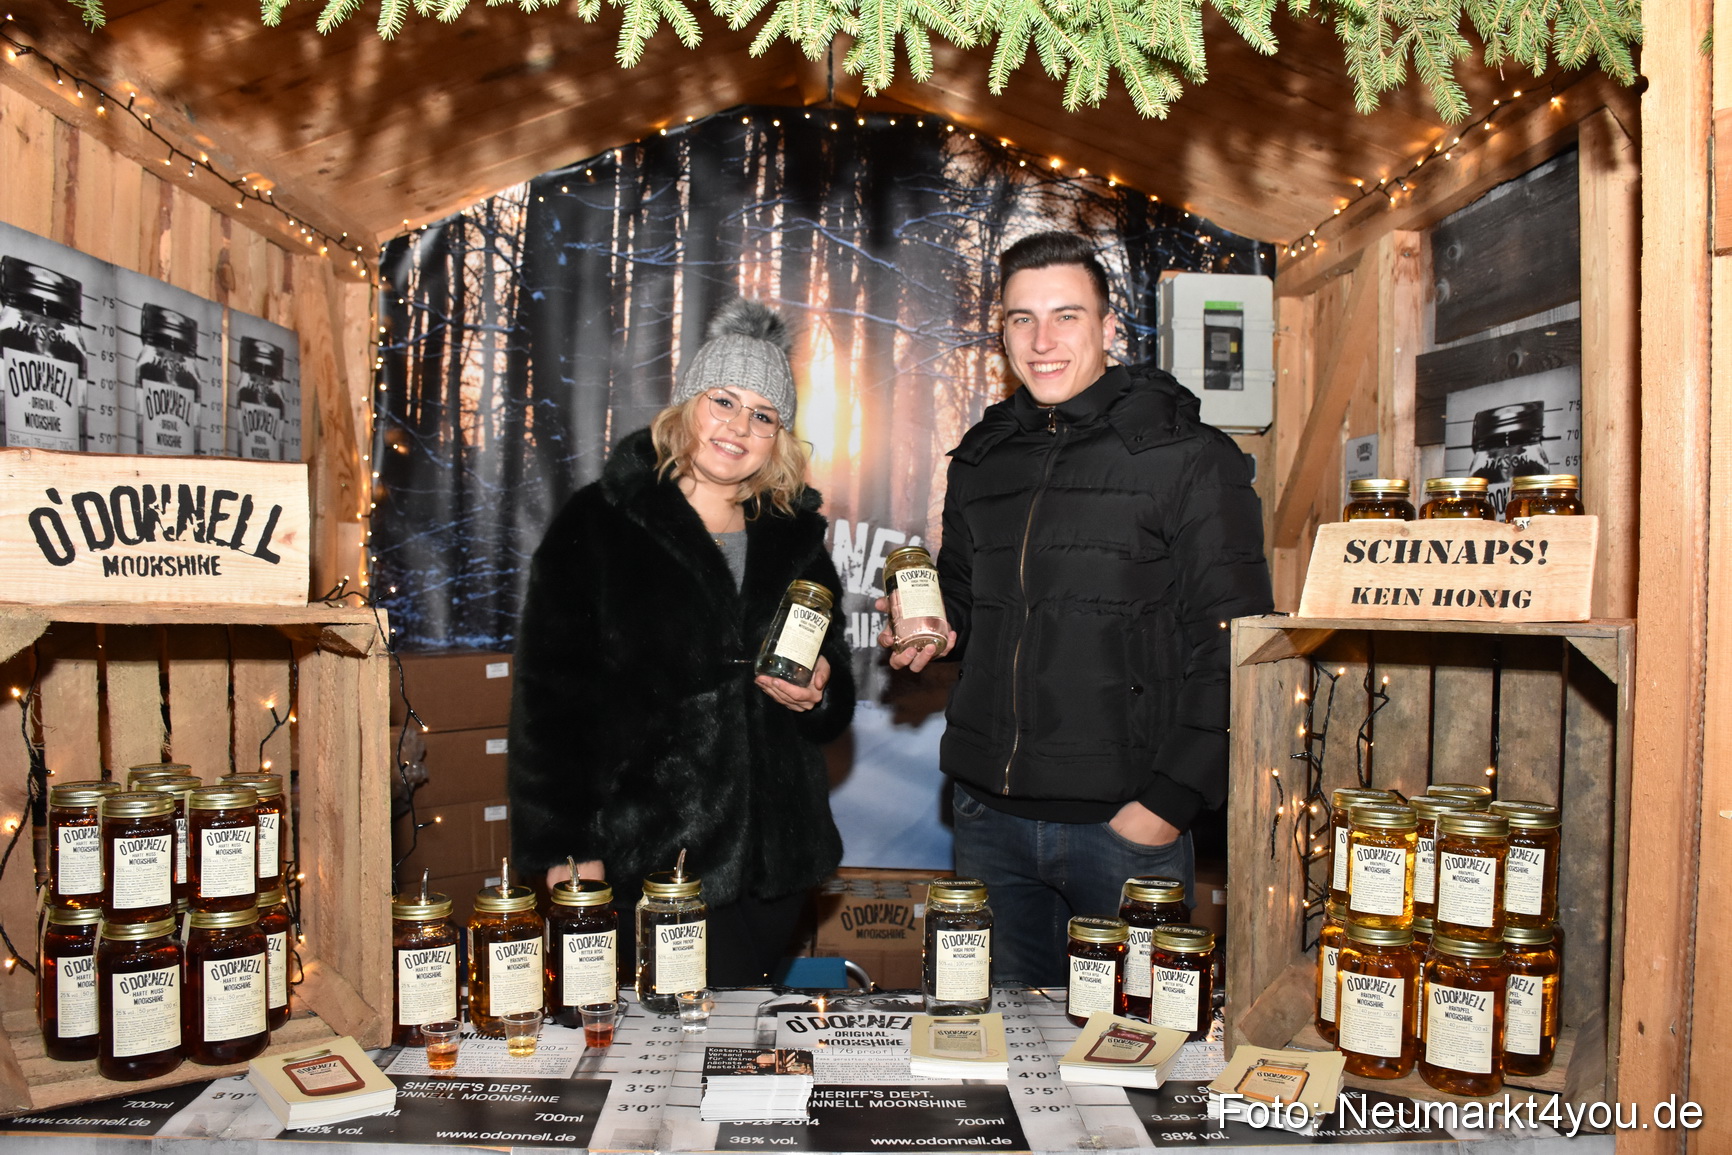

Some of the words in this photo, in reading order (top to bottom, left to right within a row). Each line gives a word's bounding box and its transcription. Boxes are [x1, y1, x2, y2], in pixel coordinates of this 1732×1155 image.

[28, 484, 283, 567] O'DONNELL
[1343, 539, 1549, 566] SCHNAPS!
[102, 554, 223, 578] MOONSHINE
[1350, 587, 1424, 606] KEIN
[1431, 589, 1532, 609] HONIG
[119, 838, 167, 856] O'DONNELL
[206, 830, 251, 847] O'DONNELL
[1356, 847, 1402, 866] O'DONNELL
[1444, 856, 1491, 876] O'DONNELL
[840, 903, 917, 932] O'DONNELL
[660, 925, 704, 944] O'DONNELL
[856, 928, 907, 940] MOONSHINE
[941, 933, 987, 950] O'DONNELL
[495, 942, 538, 961] O'DONNELL
[568, 935, 613, 953] O'DONNELL
[404, 950, 451, 970] O'DONNELL
[1073, 959, 1111, 976] O'DONNELL
[210, 959, 261, 981] O'DONNELL
[1156, 968, 1196, 987] O'DONNELL
[119, 972, 175, 995] O'DONNELL
[1346, 975, 1397, 998] O'DONNELL
[1434, 988, 1487, 1012] O'DONNELL
[818, 1038, 905, 1047] MOONSHINE
[402, 1081, 484, 1093] SHERIFF'S
[487, 1083, 532, 1094] DEPT.
[889, 1090, 934, 1099] DEPT.
[122, 1100, 174, 1110] 700ml
[461, 1092, 560, 1104] MOONSHINE
[869, 1100, 967, 1109] MOONSHINE
[12, 1115, 151, 1128] www.odonnell.de
[534, 1112, 584, 1123] 700ml
[954, 1117, 1006, 1126] 700ml
[336, 1126, 363, 1136] vol.
[436, 1130, 577, 1143] www.odonnell.de
[1160, 1131, 1197, 1142] 38%
[1200, 1131, 1230, 1141] vol.
[729, 1135, 765, 1146] 38%
[769, 1136, 799, 1146] vol.
[870, 1135, 1013, 1147] www.odonnell.de
